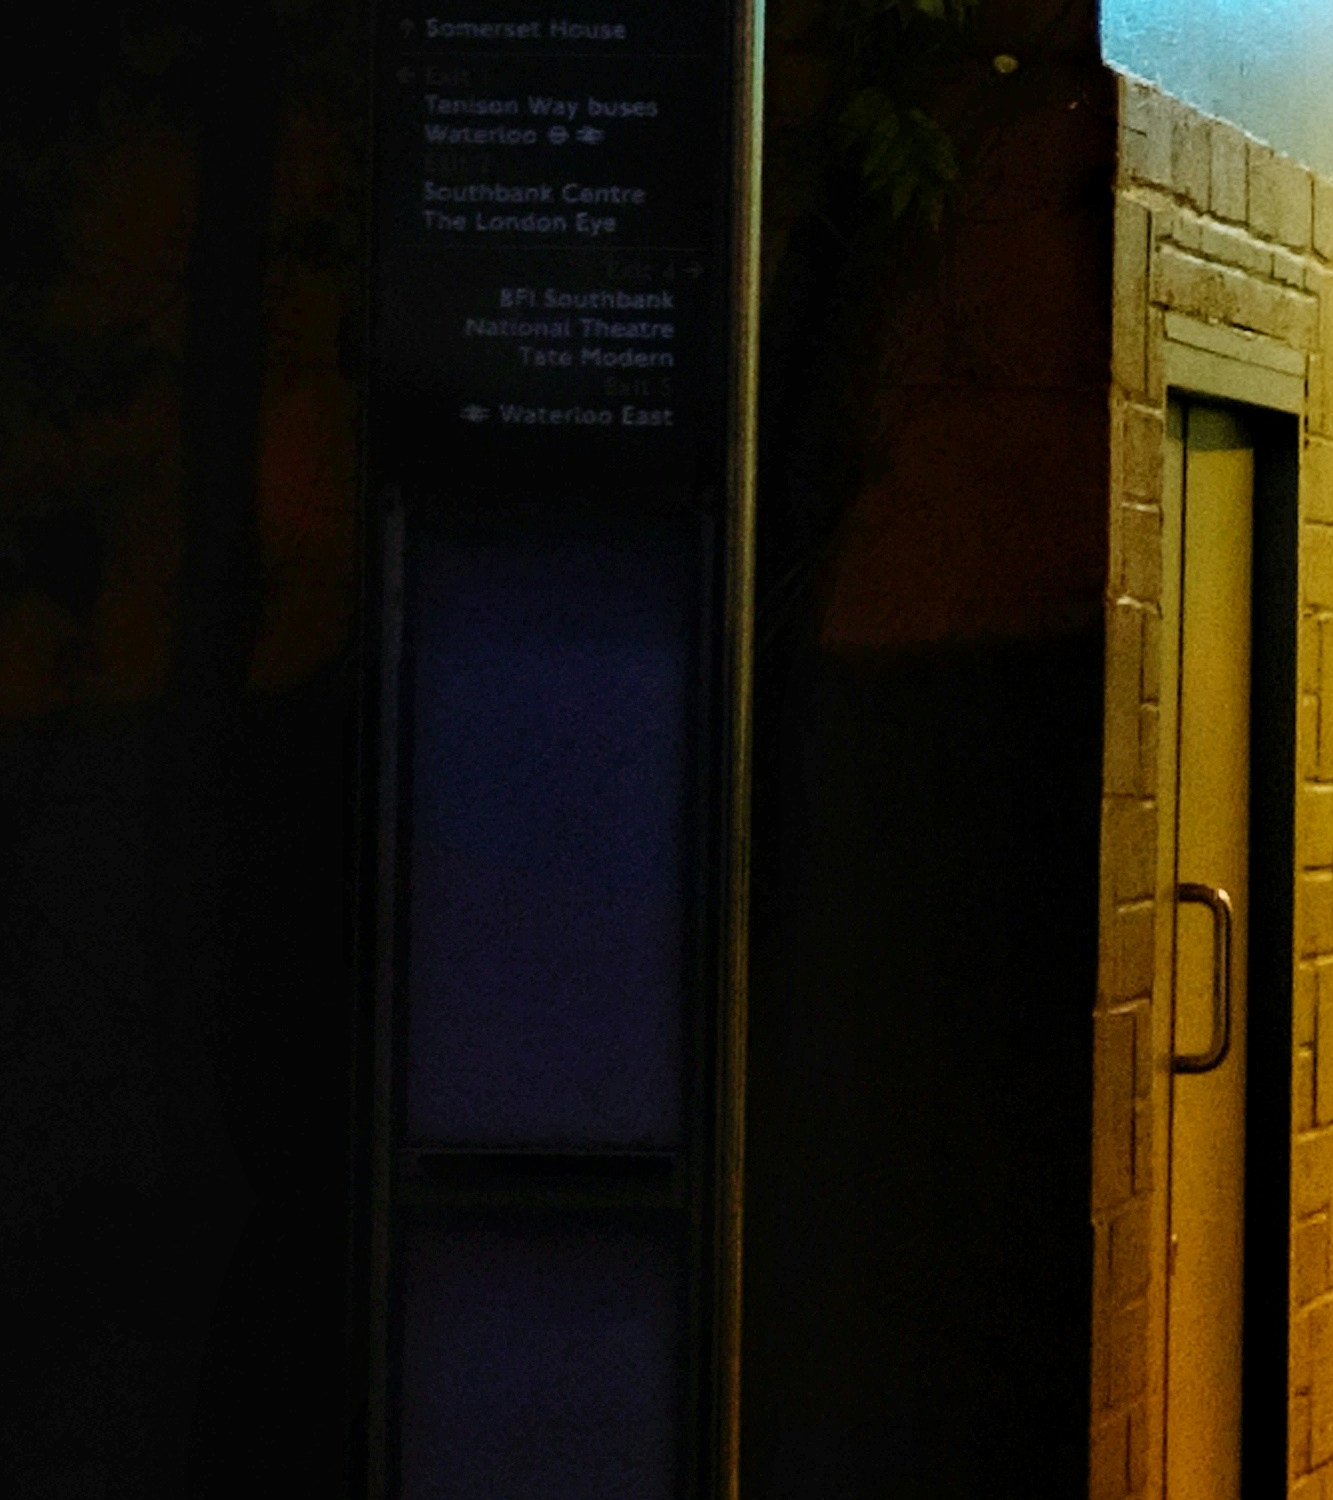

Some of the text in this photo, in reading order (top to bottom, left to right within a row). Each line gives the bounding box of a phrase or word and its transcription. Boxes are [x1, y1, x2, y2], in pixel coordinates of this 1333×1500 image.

[426, 17, 627, 40] Somerset House
[424, 93, 659, 121] Tenison Way buses
[424, 123, 538, 145] Waterloo
[423, 180, 647, 205] Southbank Centre
[423, 209, 617, 237] The London Eye
[500, 287, 676, 310] BFI Southbank
[464, 317, 676, 339] National Theatre
[519, 345, 676, 369] Tate Modern
[500, 403, 675, 428] Waterloo East
